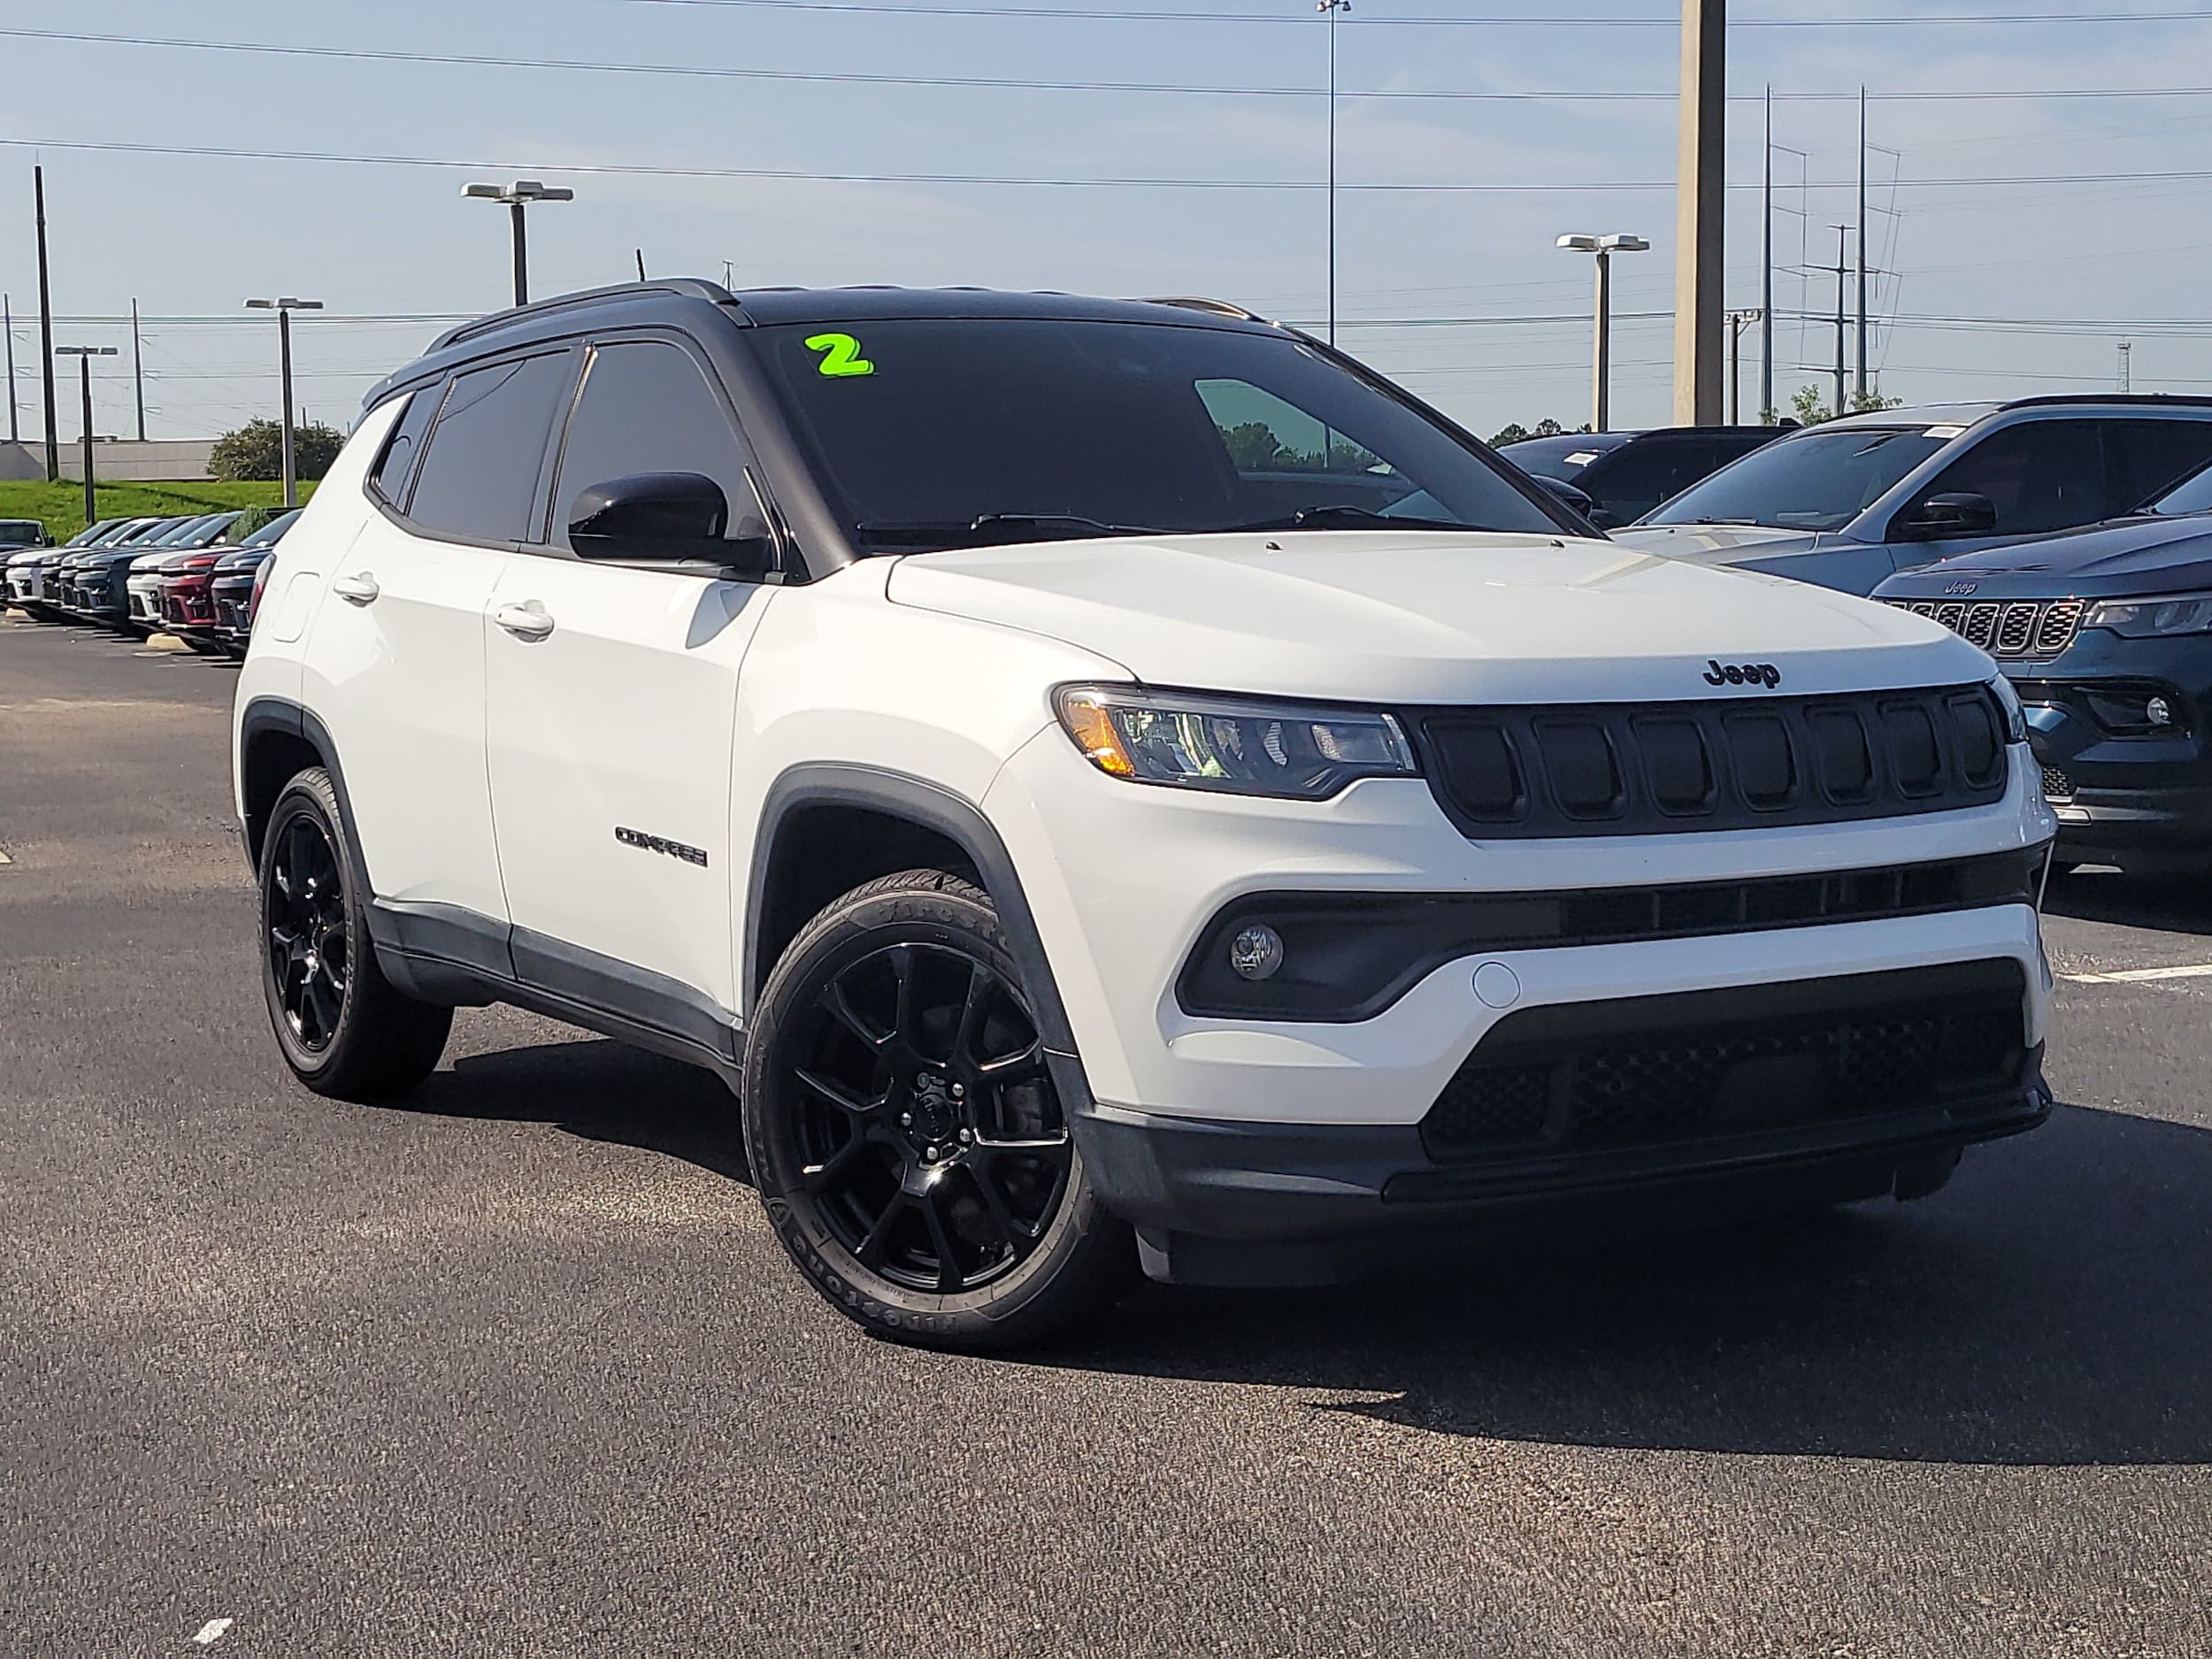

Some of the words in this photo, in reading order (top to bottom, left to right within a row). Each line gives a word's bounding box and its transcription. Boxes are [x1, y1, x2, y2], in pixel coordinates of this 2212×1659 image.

[804, 333, 875, 377] 2
[1945, 580, 1978, 596] Jeep
[1702, 659, 1781, 689] Jeep
